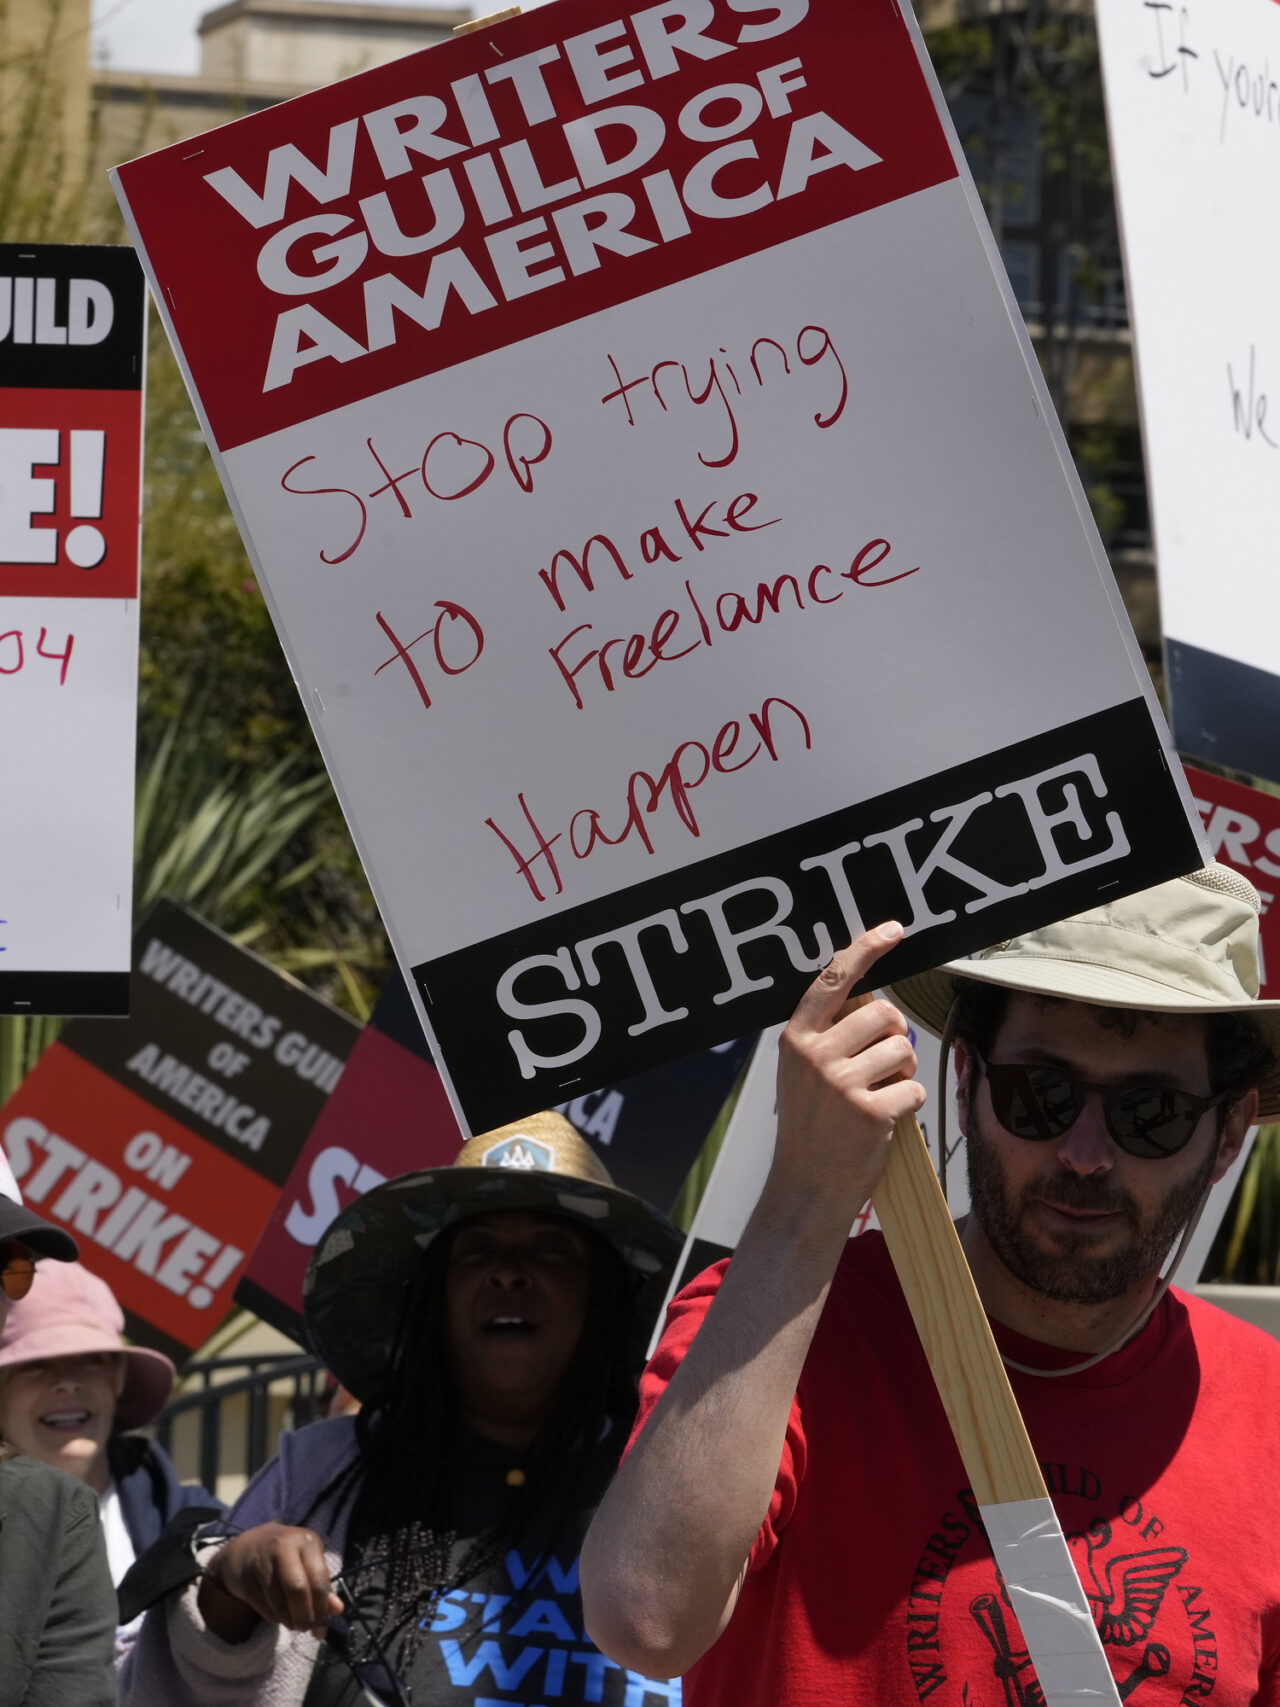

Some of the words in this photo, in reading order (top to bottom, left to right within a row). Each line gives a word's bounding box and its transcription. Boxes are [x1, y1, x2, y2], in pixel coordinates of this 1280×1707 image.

[202, 0, 811, 230] WRITERS
[1144, 2, 1199, 94] If
[256, 104, 667, 297] GUILD
[677, 57, 809, 144] OF
[262, 111, 884, 394] AMERICA
[281, 413, 553, 566] Stop
[601, 325, 849, 469] trying
[1227, 343, 1280, 449] We
[374, 600, 484, 709] to
[548, 538, 921, 709] Freelance
[484, 697, 812, 902] Happen
[495, 753, 1132, 1081] STRIKE
[138, 937, 283, 1050] WRITERS
[206, 1041, 251, 1079] OF
[123, 1130, 194, 1191] ON
[125, 1042, 272, 1152] AMERICA
[4, 1116, 246, 1311] STRIKE!
[1120, 1494, 1166, 1542] OF
[420, 1587, 596, 1644] STA
[906, 1512, 971, 1700] WRITERS
